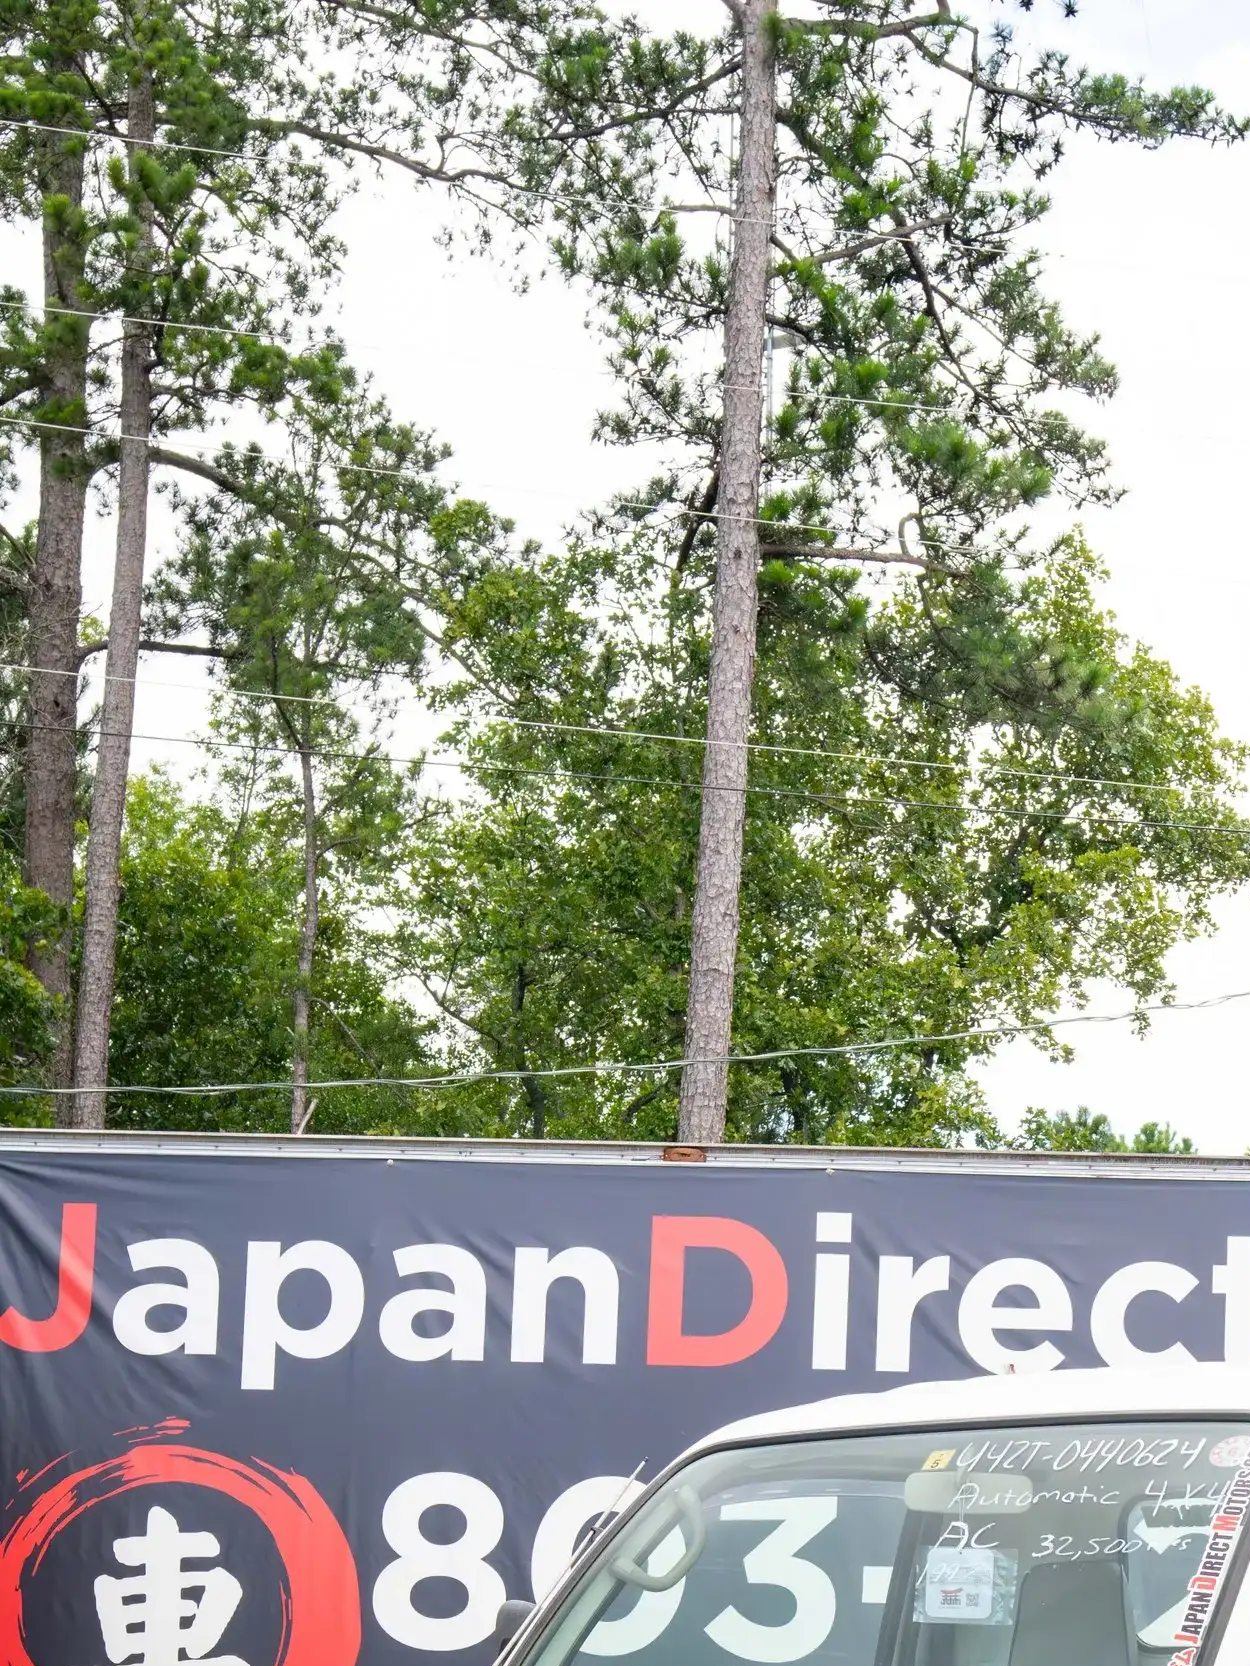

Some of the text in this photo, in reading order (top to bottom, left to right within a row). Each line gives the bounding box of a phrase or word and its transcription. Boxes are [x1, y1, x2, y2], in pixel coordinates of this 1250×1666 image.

[948, 1482, 1119, 1509] Automatic
[934, 1521, 1000, 1551] AC
[1032, 1534, 1143, 1560] 32,500
